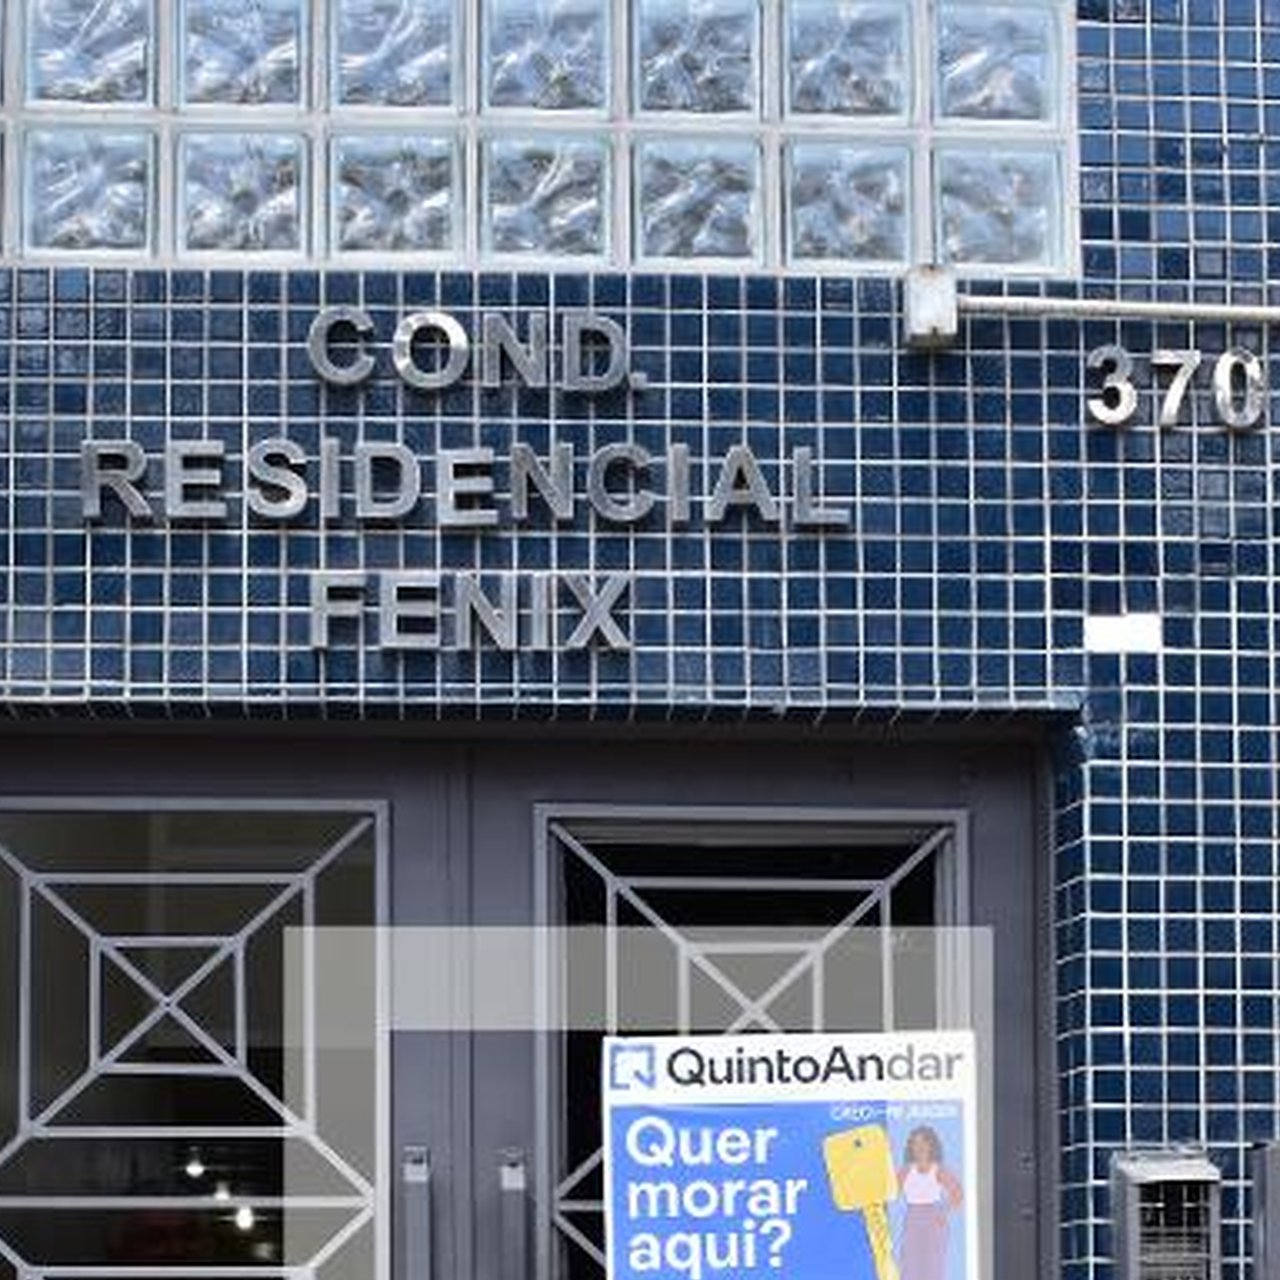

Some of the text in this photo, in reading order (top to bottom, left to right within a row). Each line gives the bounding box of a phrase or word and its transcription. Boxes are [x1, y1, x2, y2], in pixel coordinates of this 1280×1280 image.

[308, 306, 647, 392] COND.
[1087, 343, 1263, 427] 370
[80, 438, 852, 526] RESIDENCIAL
[310, 570, 632, 652] FENIX
[666, 1044, 962, 1086] QuintoAndar
[626, 1116, 779, 1166] Quer
[628, 1177, 808, 1219] morar
[629, 1219, 793, 1280] aqui?
